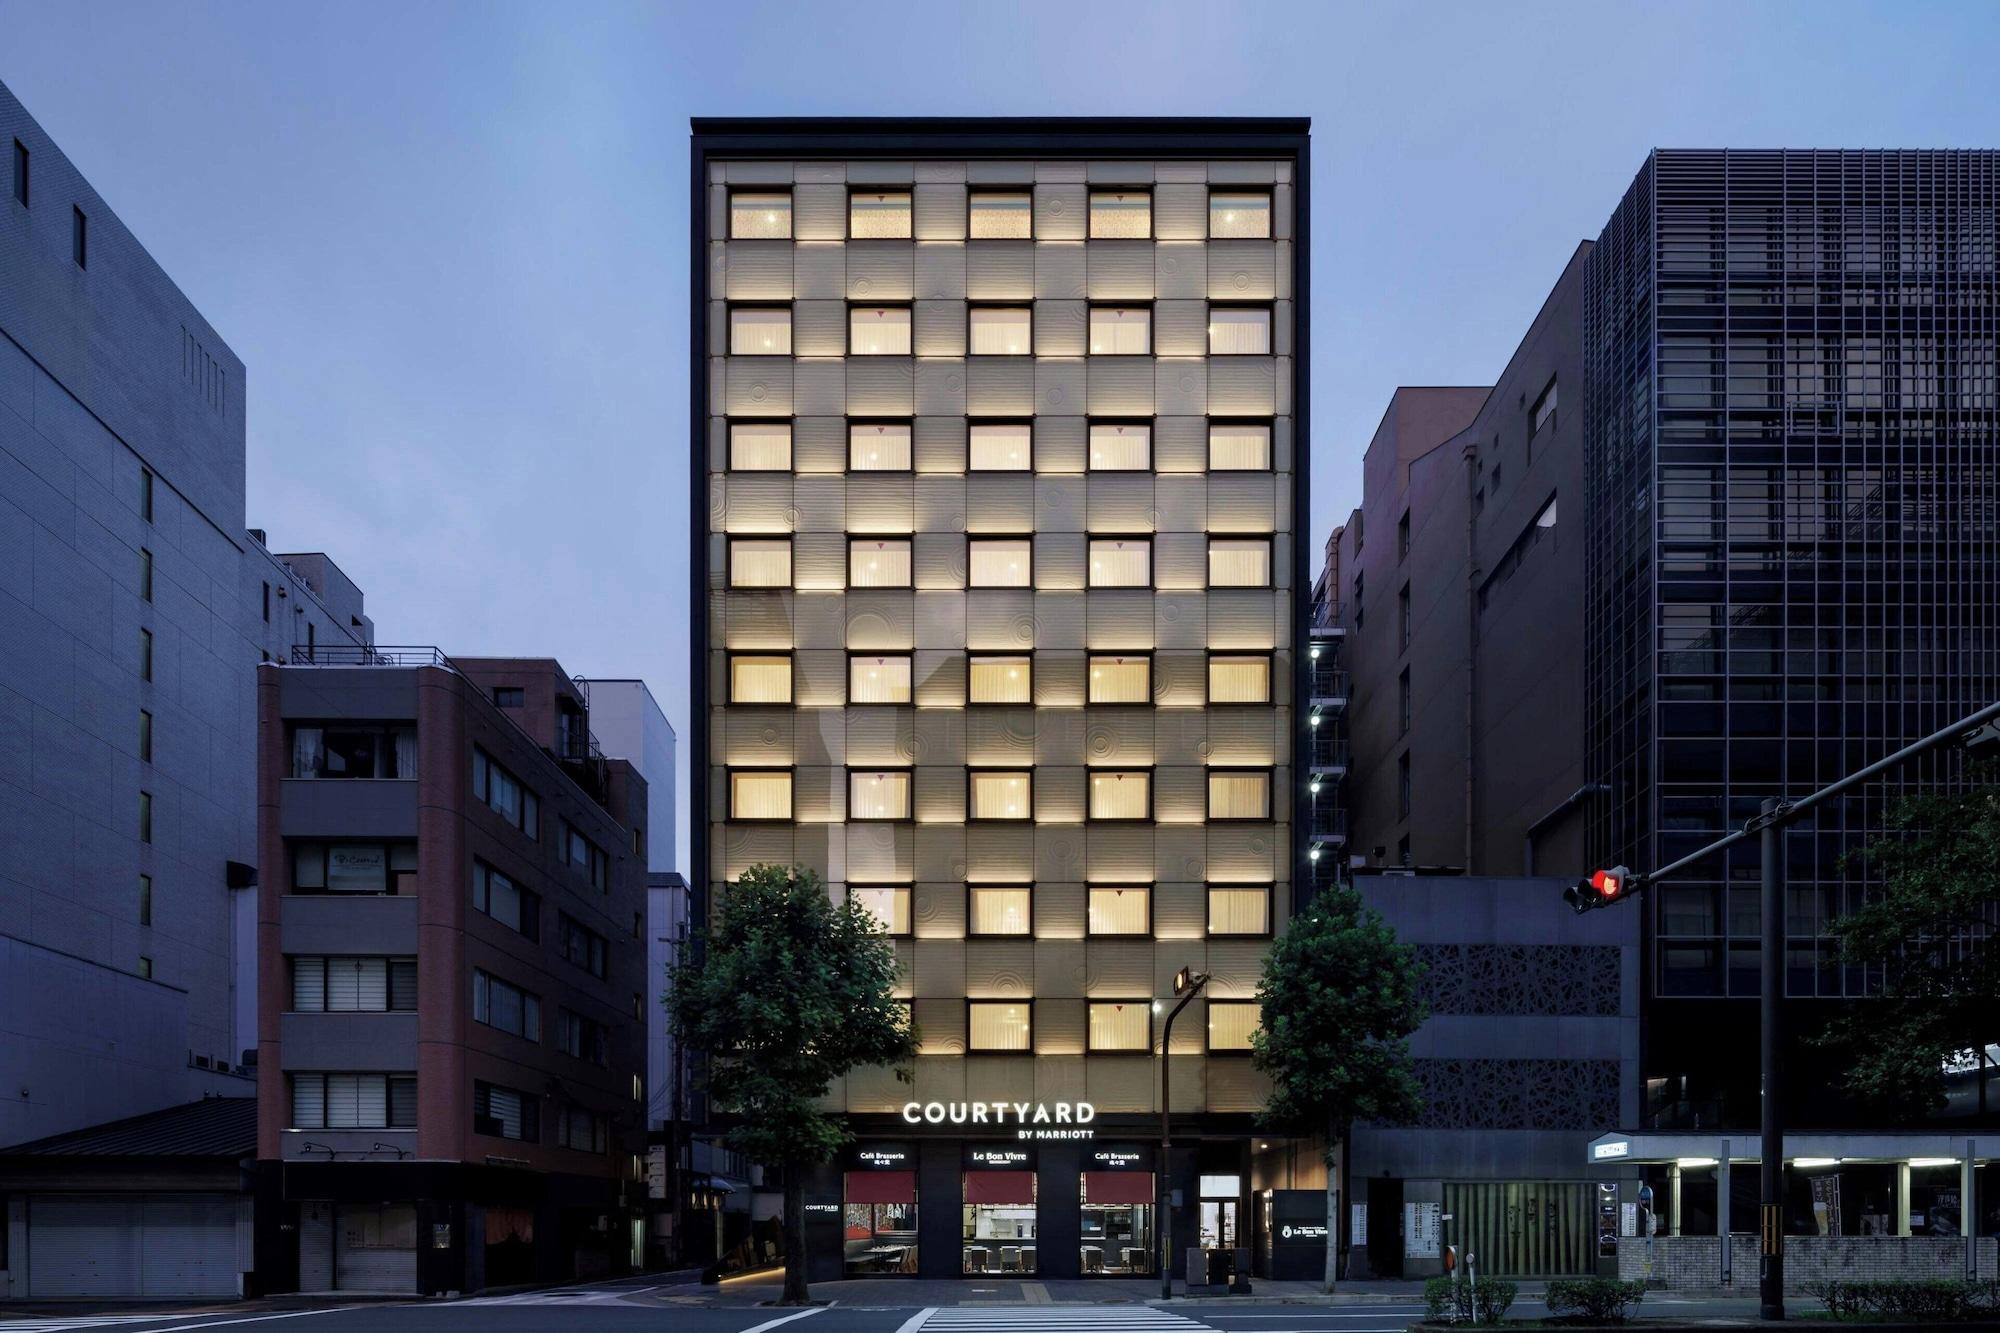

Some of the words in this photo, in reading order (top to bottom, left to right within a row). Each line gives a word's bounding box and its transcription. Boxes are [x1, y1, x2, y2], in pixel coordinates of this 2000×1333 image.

[902, 1101, 1095, 1124] COURTYARD
[1018, 1130, 1032, 1139] BY
[1036, 1130, 1095, 1139] MARRIOTT
[973, 1152, 985, 1160] Le
[986, 1152, 1003, 1160] Bon
[1004, 1152, 1027, 1160] Vivre
[1110, 1152, 1140, 1160] Brasserie
